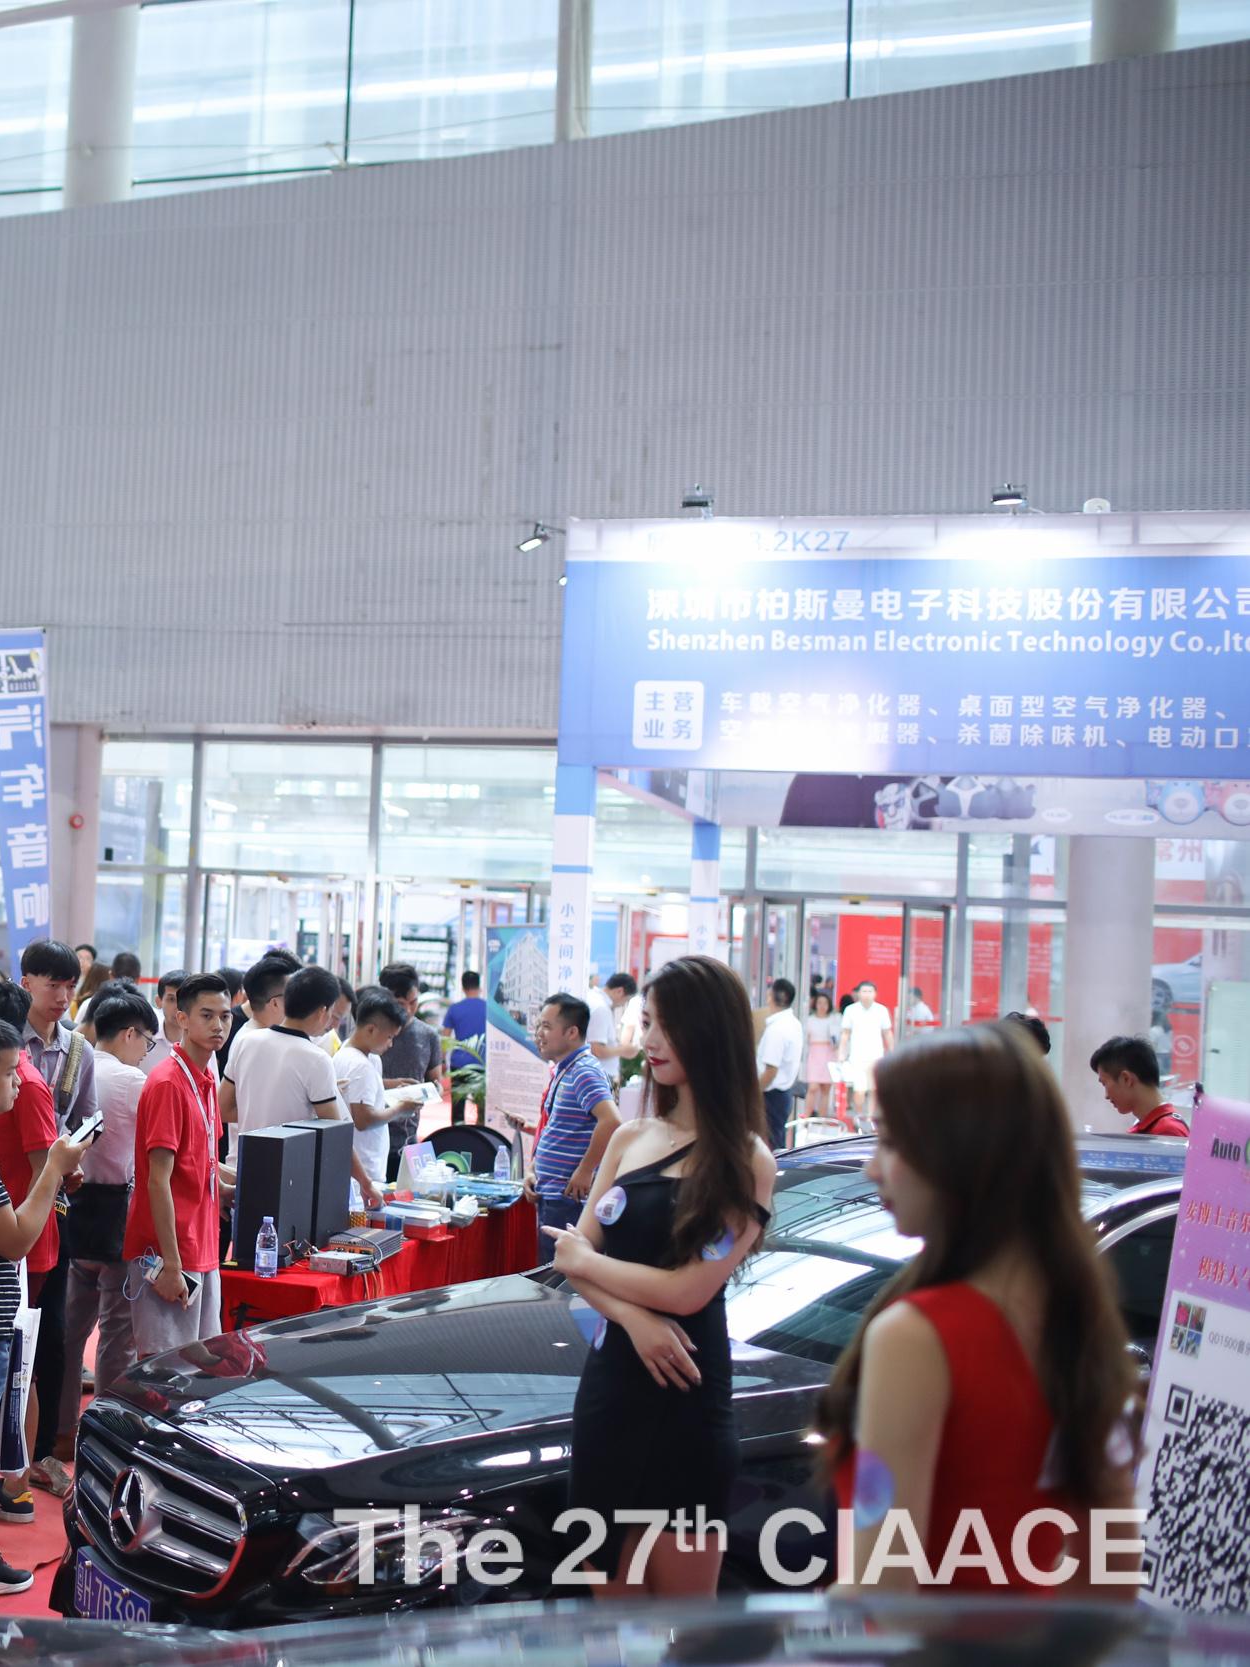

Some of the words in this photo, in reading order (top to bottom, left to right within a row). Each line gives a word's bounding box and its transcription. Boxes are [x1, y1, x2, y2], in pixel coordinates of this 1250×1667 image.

[647, 629, 765, 652] Shenzhen
[770, 630, 868, 652] Besman
[873, 629, 1002, 652] Electronic
[1006, 629, 1164, 657] Technology
[644, 691, 695, 712] 主营
[643, 718, 694, 739] 业务
[1211, 1138, 1241, 1162] Auto
